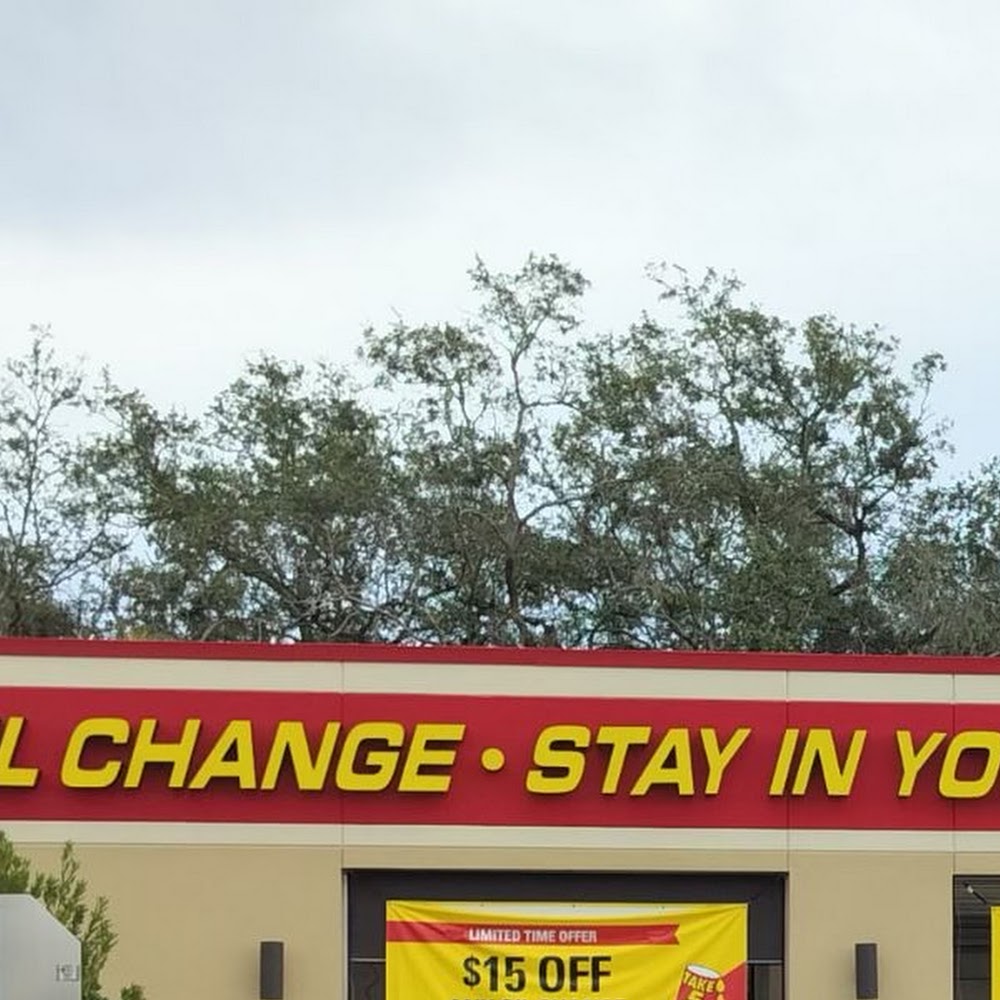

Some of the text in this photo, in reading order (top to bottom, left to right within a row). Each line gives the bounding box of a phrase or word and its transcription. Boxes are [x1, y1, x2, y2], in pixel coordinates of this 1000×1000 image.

[60, 717, 466, 793] CHANGE
[525, 724, 752, 797] STAY
[768, 728, 867, 797] IN
[467, 928, 598, 943] LIMITED TIME OFFER
[462, 954, 612, 993] $15 OFF
[682, 970, 717, 993] TAKE
